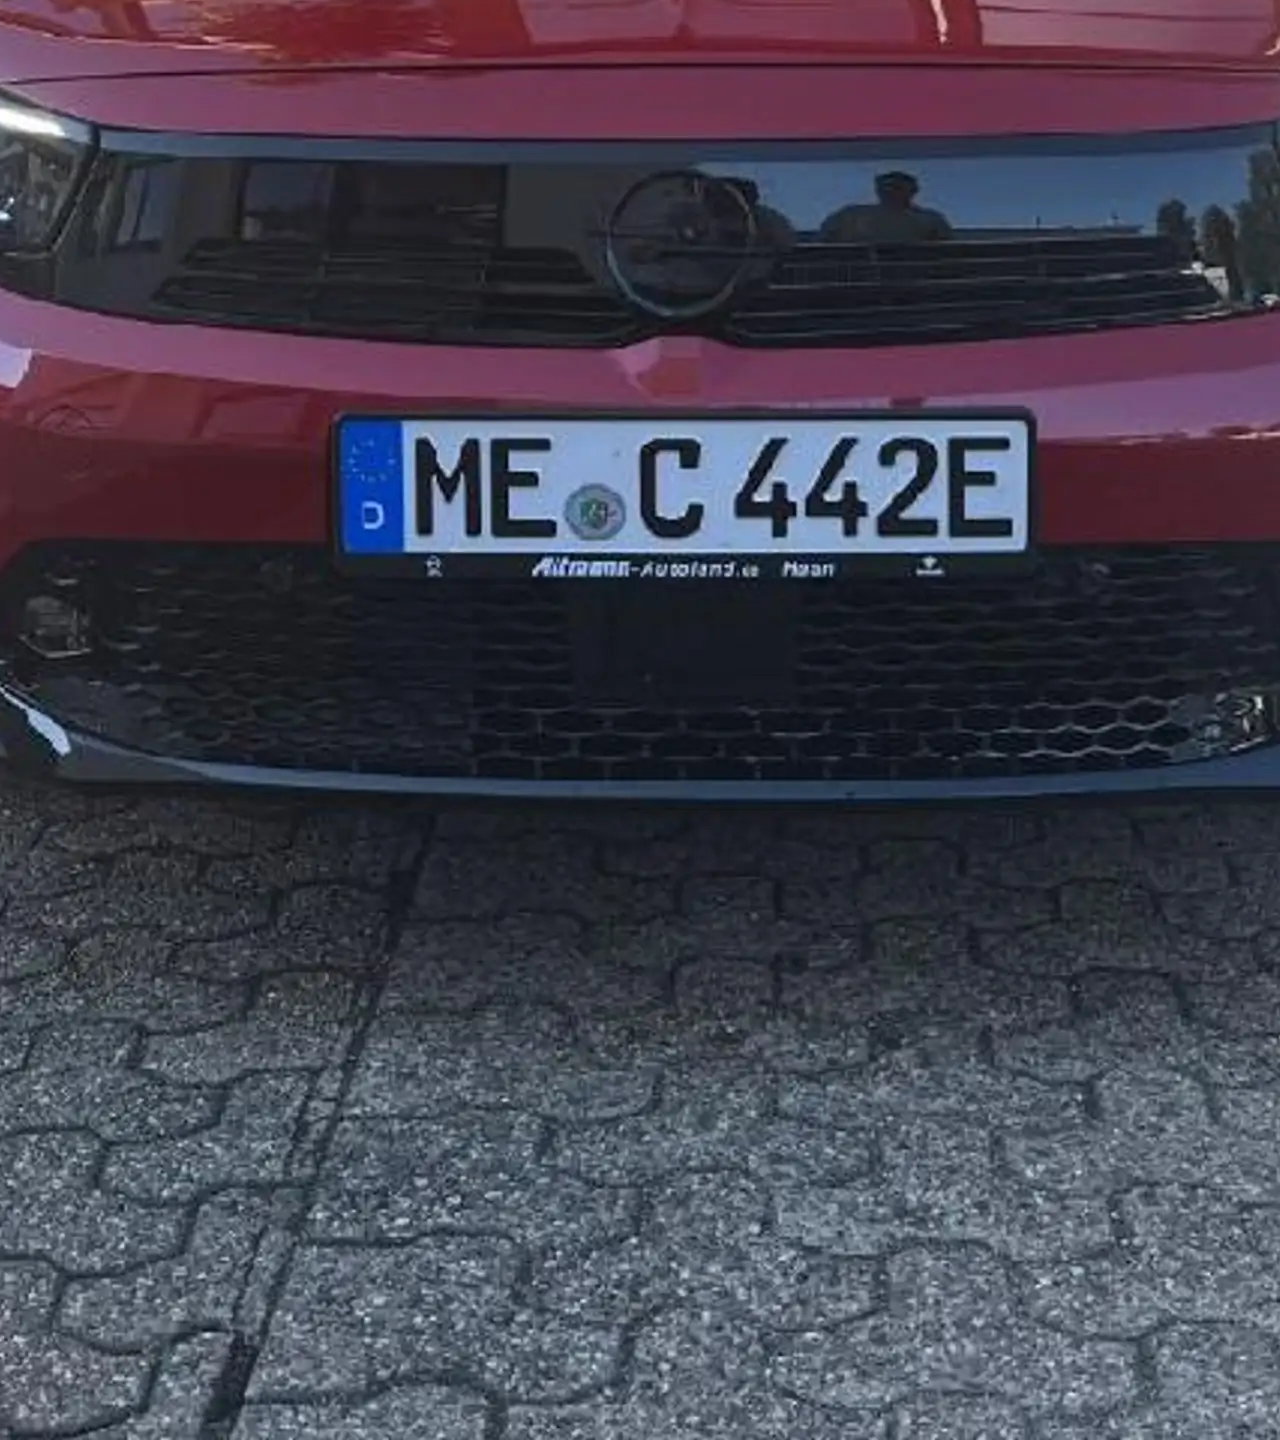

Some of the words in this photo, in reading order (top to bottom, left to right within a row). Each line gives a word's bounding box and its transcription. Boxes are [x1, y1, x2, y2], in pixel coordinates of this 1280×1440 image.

[415, 436, 557, 538] ME
[638, 436, 705, 538] C
[733, 436, 1014, 538] 442E
[362, 501, 385, 530] D
[781, 560, 834, 578] Haan
